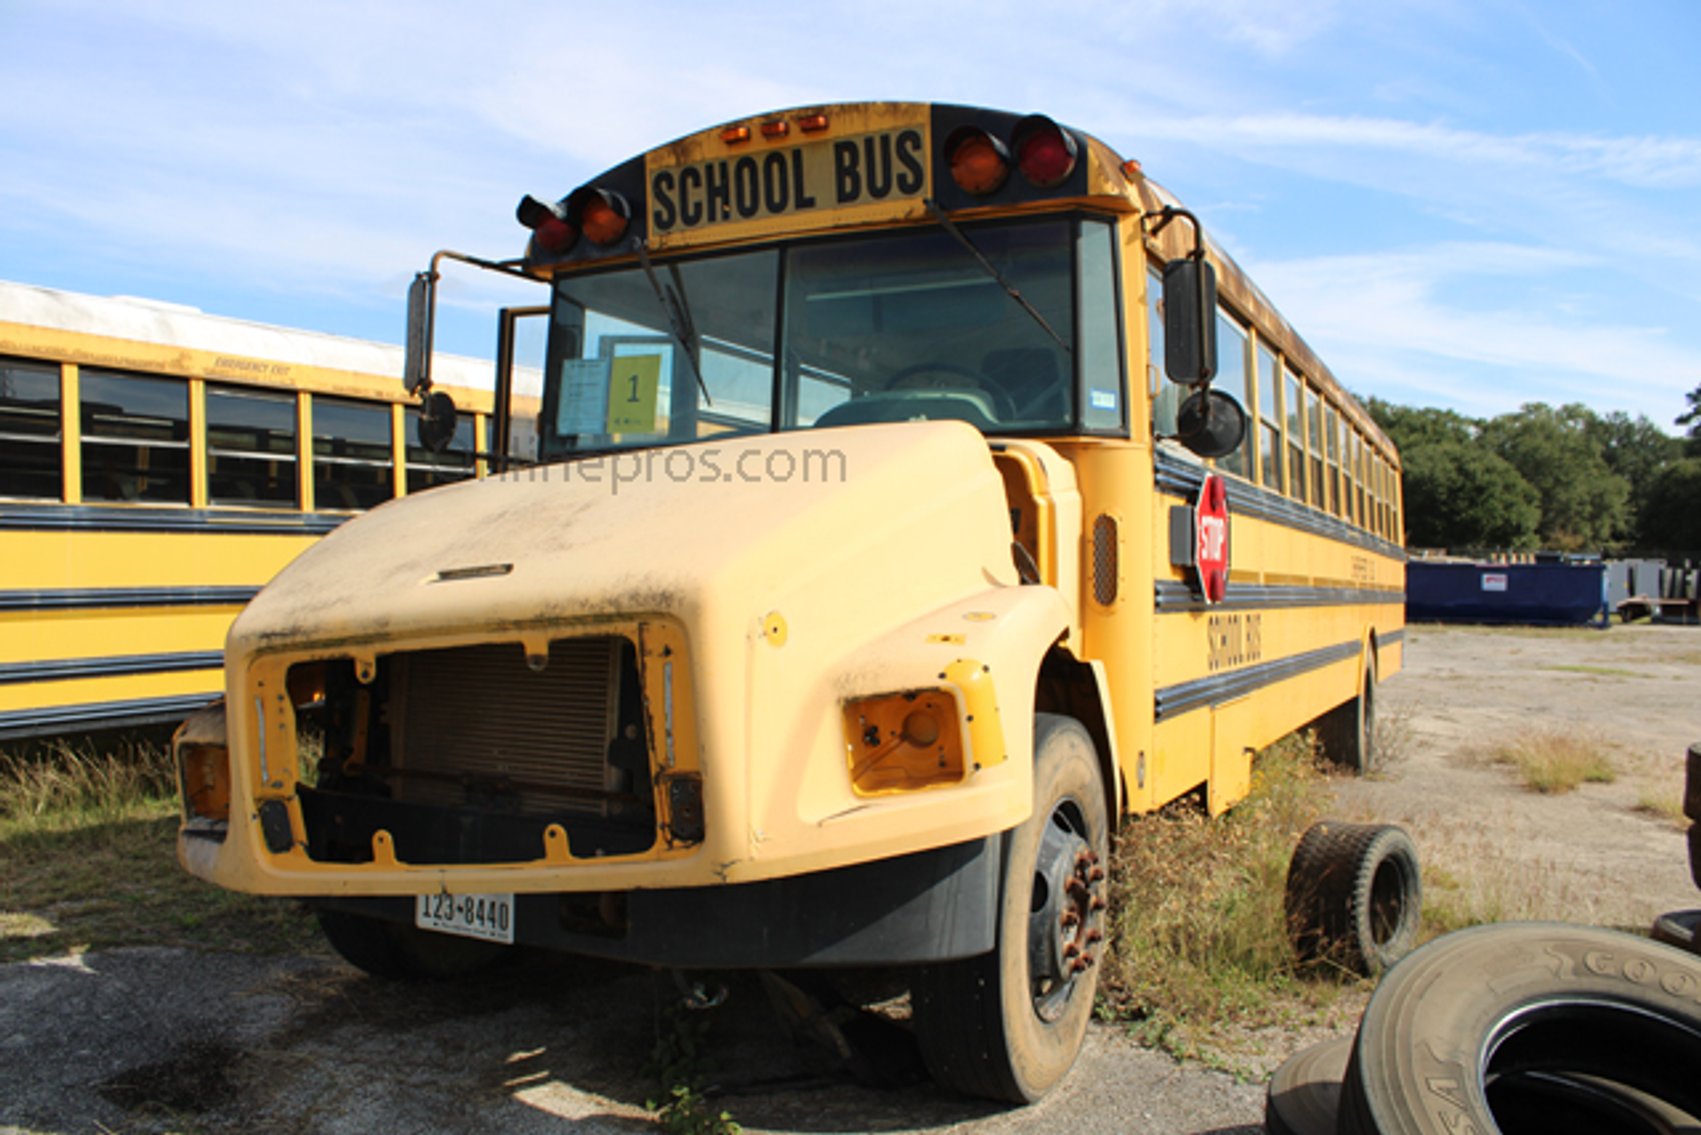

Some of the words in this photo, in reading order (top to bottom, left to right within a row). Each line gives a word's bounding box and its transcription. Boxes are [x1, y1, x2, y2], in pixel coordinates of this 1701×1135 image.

[652, 148, 816, 231] SCHOOL
[833, 129, 924, 204] BUS
[626, 374, 640, 403] 1
[1201, 515, 1224, 561] STOP
[1583, 950, 1701, 1004] GOO
